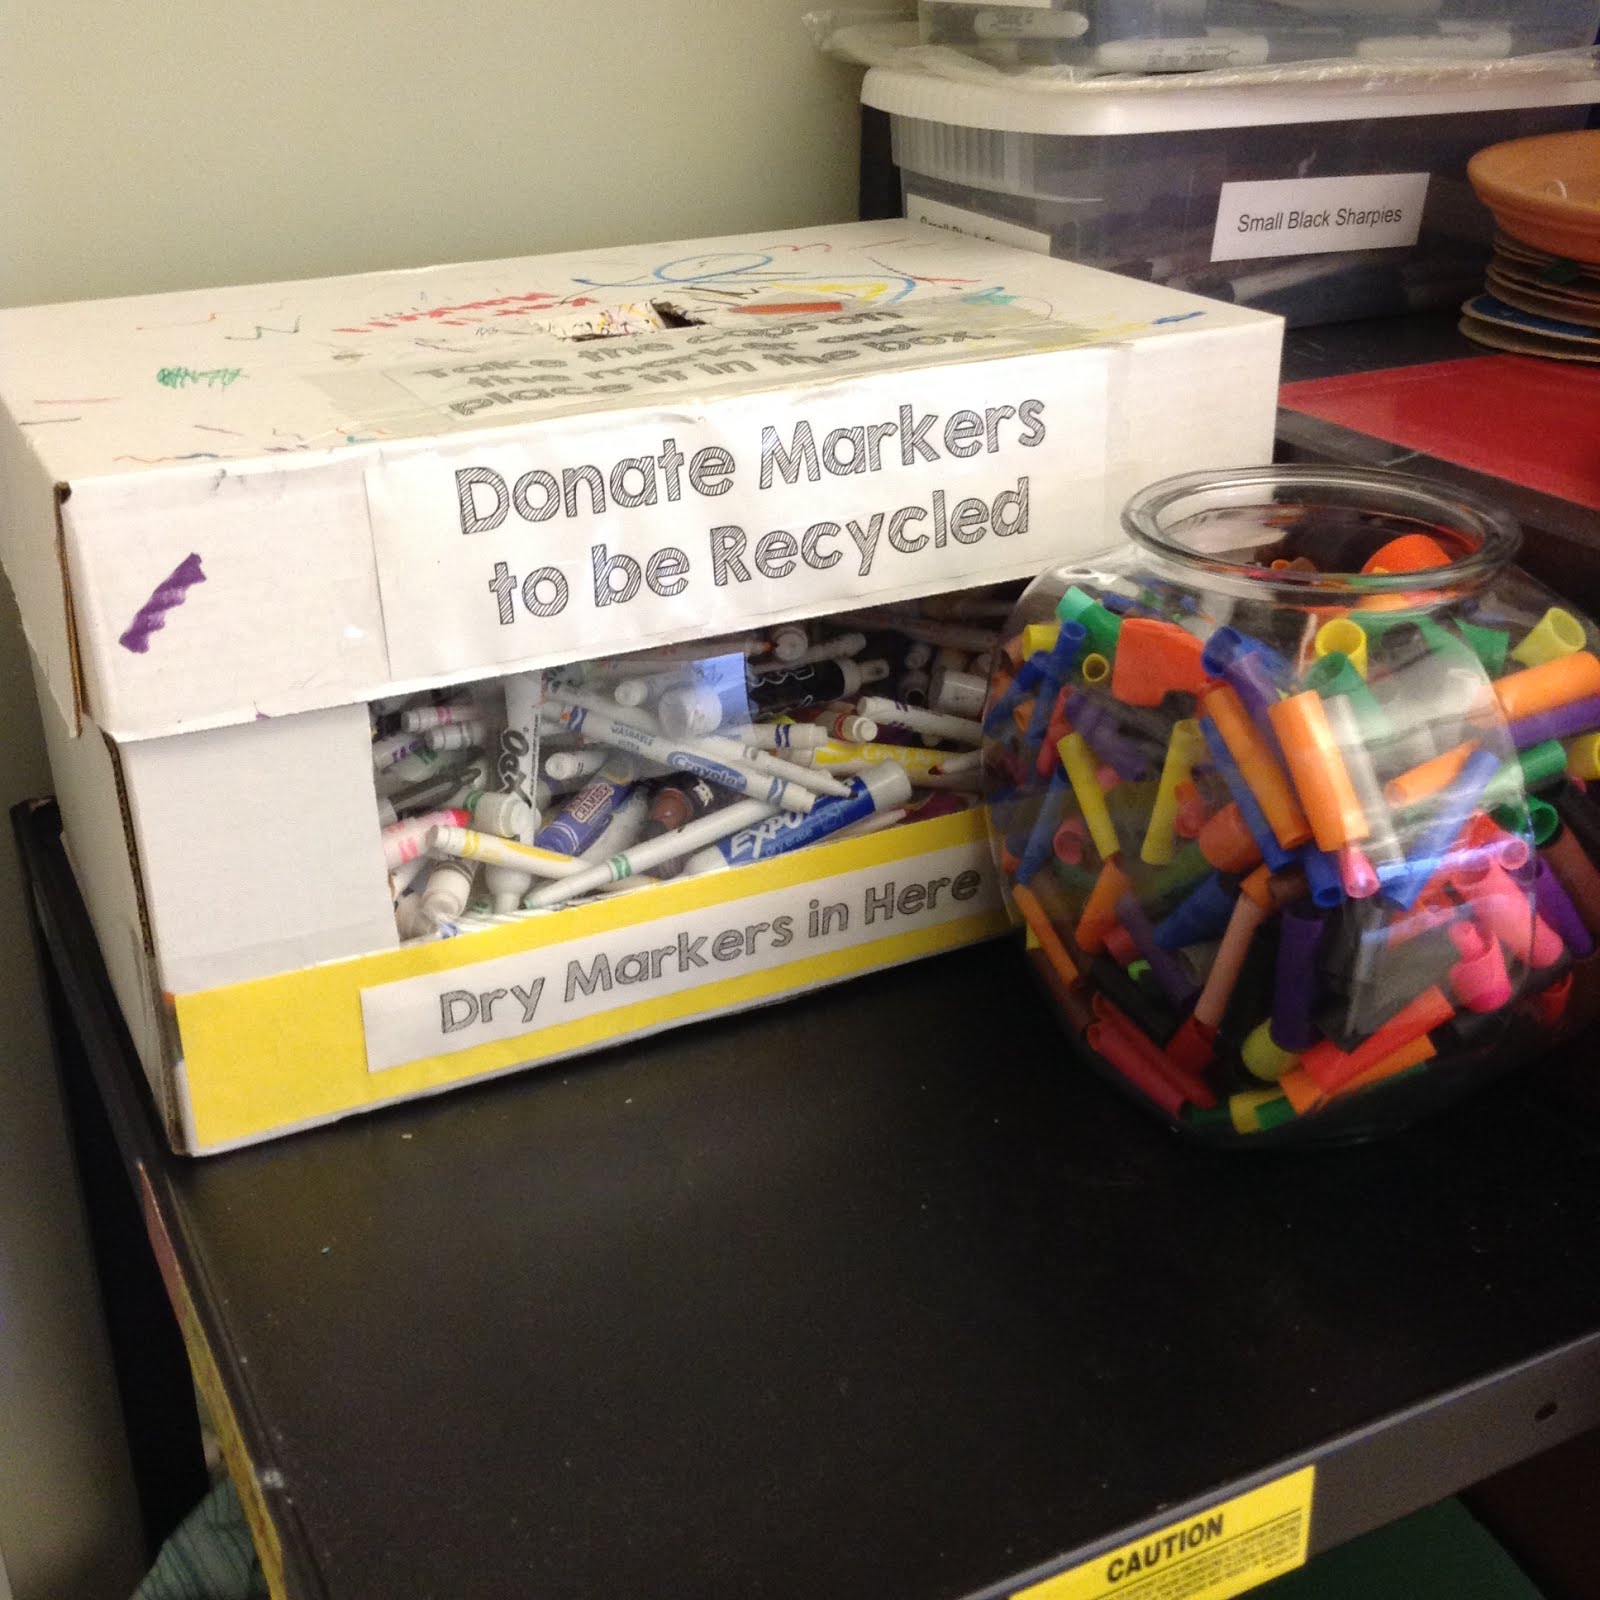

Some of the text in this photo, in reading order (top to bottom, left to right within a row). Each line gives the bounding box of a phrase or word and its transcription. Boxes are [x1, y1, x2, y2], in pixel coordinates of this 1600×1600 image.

[1237, 207, 1403, 233] Small Black Sharpies
[449, 330, 997, 416] place it in the box.
[467, 324, 924, 389] the marker and
[578, 342, 674, 363] the
[686, 321, 819, 344] caps
[455, 399, 1046, 535] Donate Markers
[489, 476, 1029, 625] to be Recycled
[731, 811, 804, 859] EXPO
[440, 869, 982, 1033] Dry Markers in Here
[1106, 1513, 1224, 1584] CAUTION
